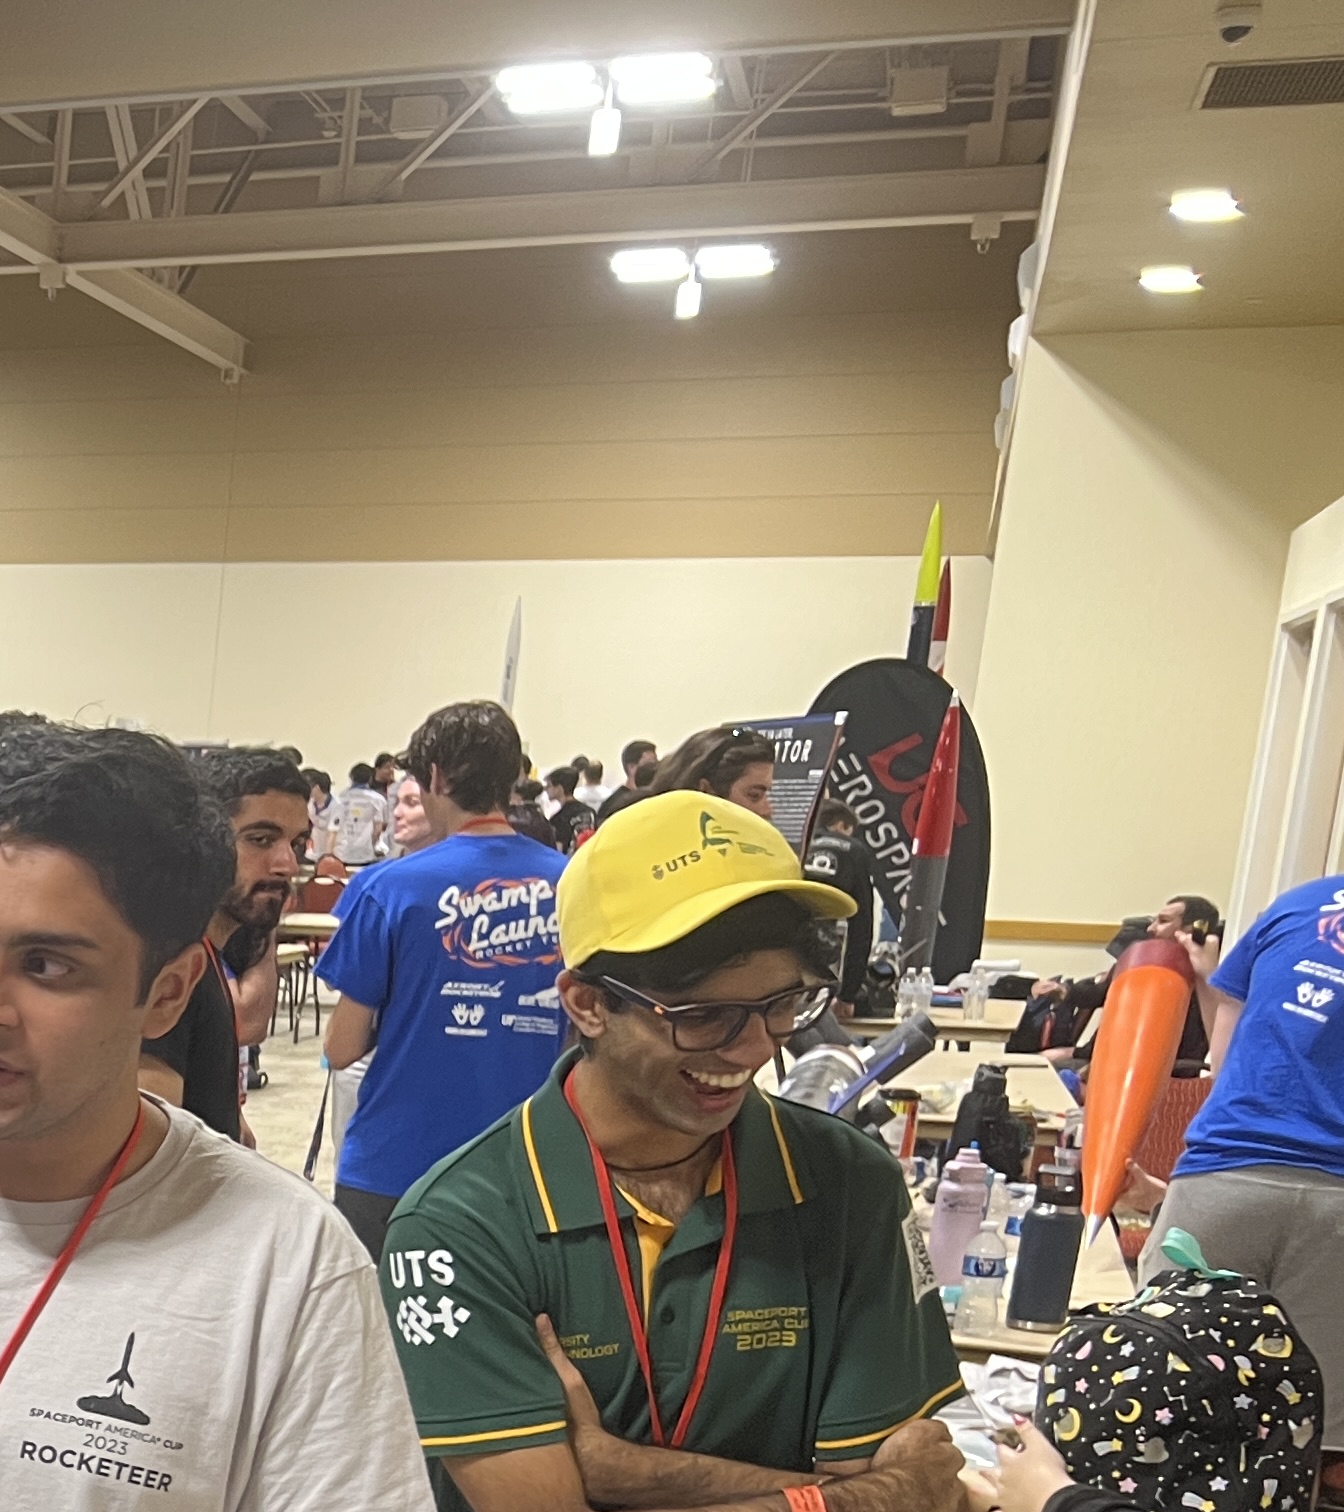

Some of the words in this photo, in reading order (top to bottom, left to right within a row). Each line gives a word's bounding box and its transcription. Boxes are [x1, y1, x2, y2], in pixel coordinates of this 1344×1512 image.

[665, 850, 701, 872] UTS
[435, 879, 554, 930] Swamp
[389, 1249, 455, 1289] UTS
[726, 1306, 808, 1322] SPACEPORT
[721, 1319, 780, 1335] AMERICA
[736, 1331, 798, 1351] 2023
[28, 1407, 102, 1430] SPACEPORT
[162, 1439, 184, 1451] CUP
[82, 1433, 129, 1456] 2023
[19, 1440, 174, 1493] ROCKETEER
